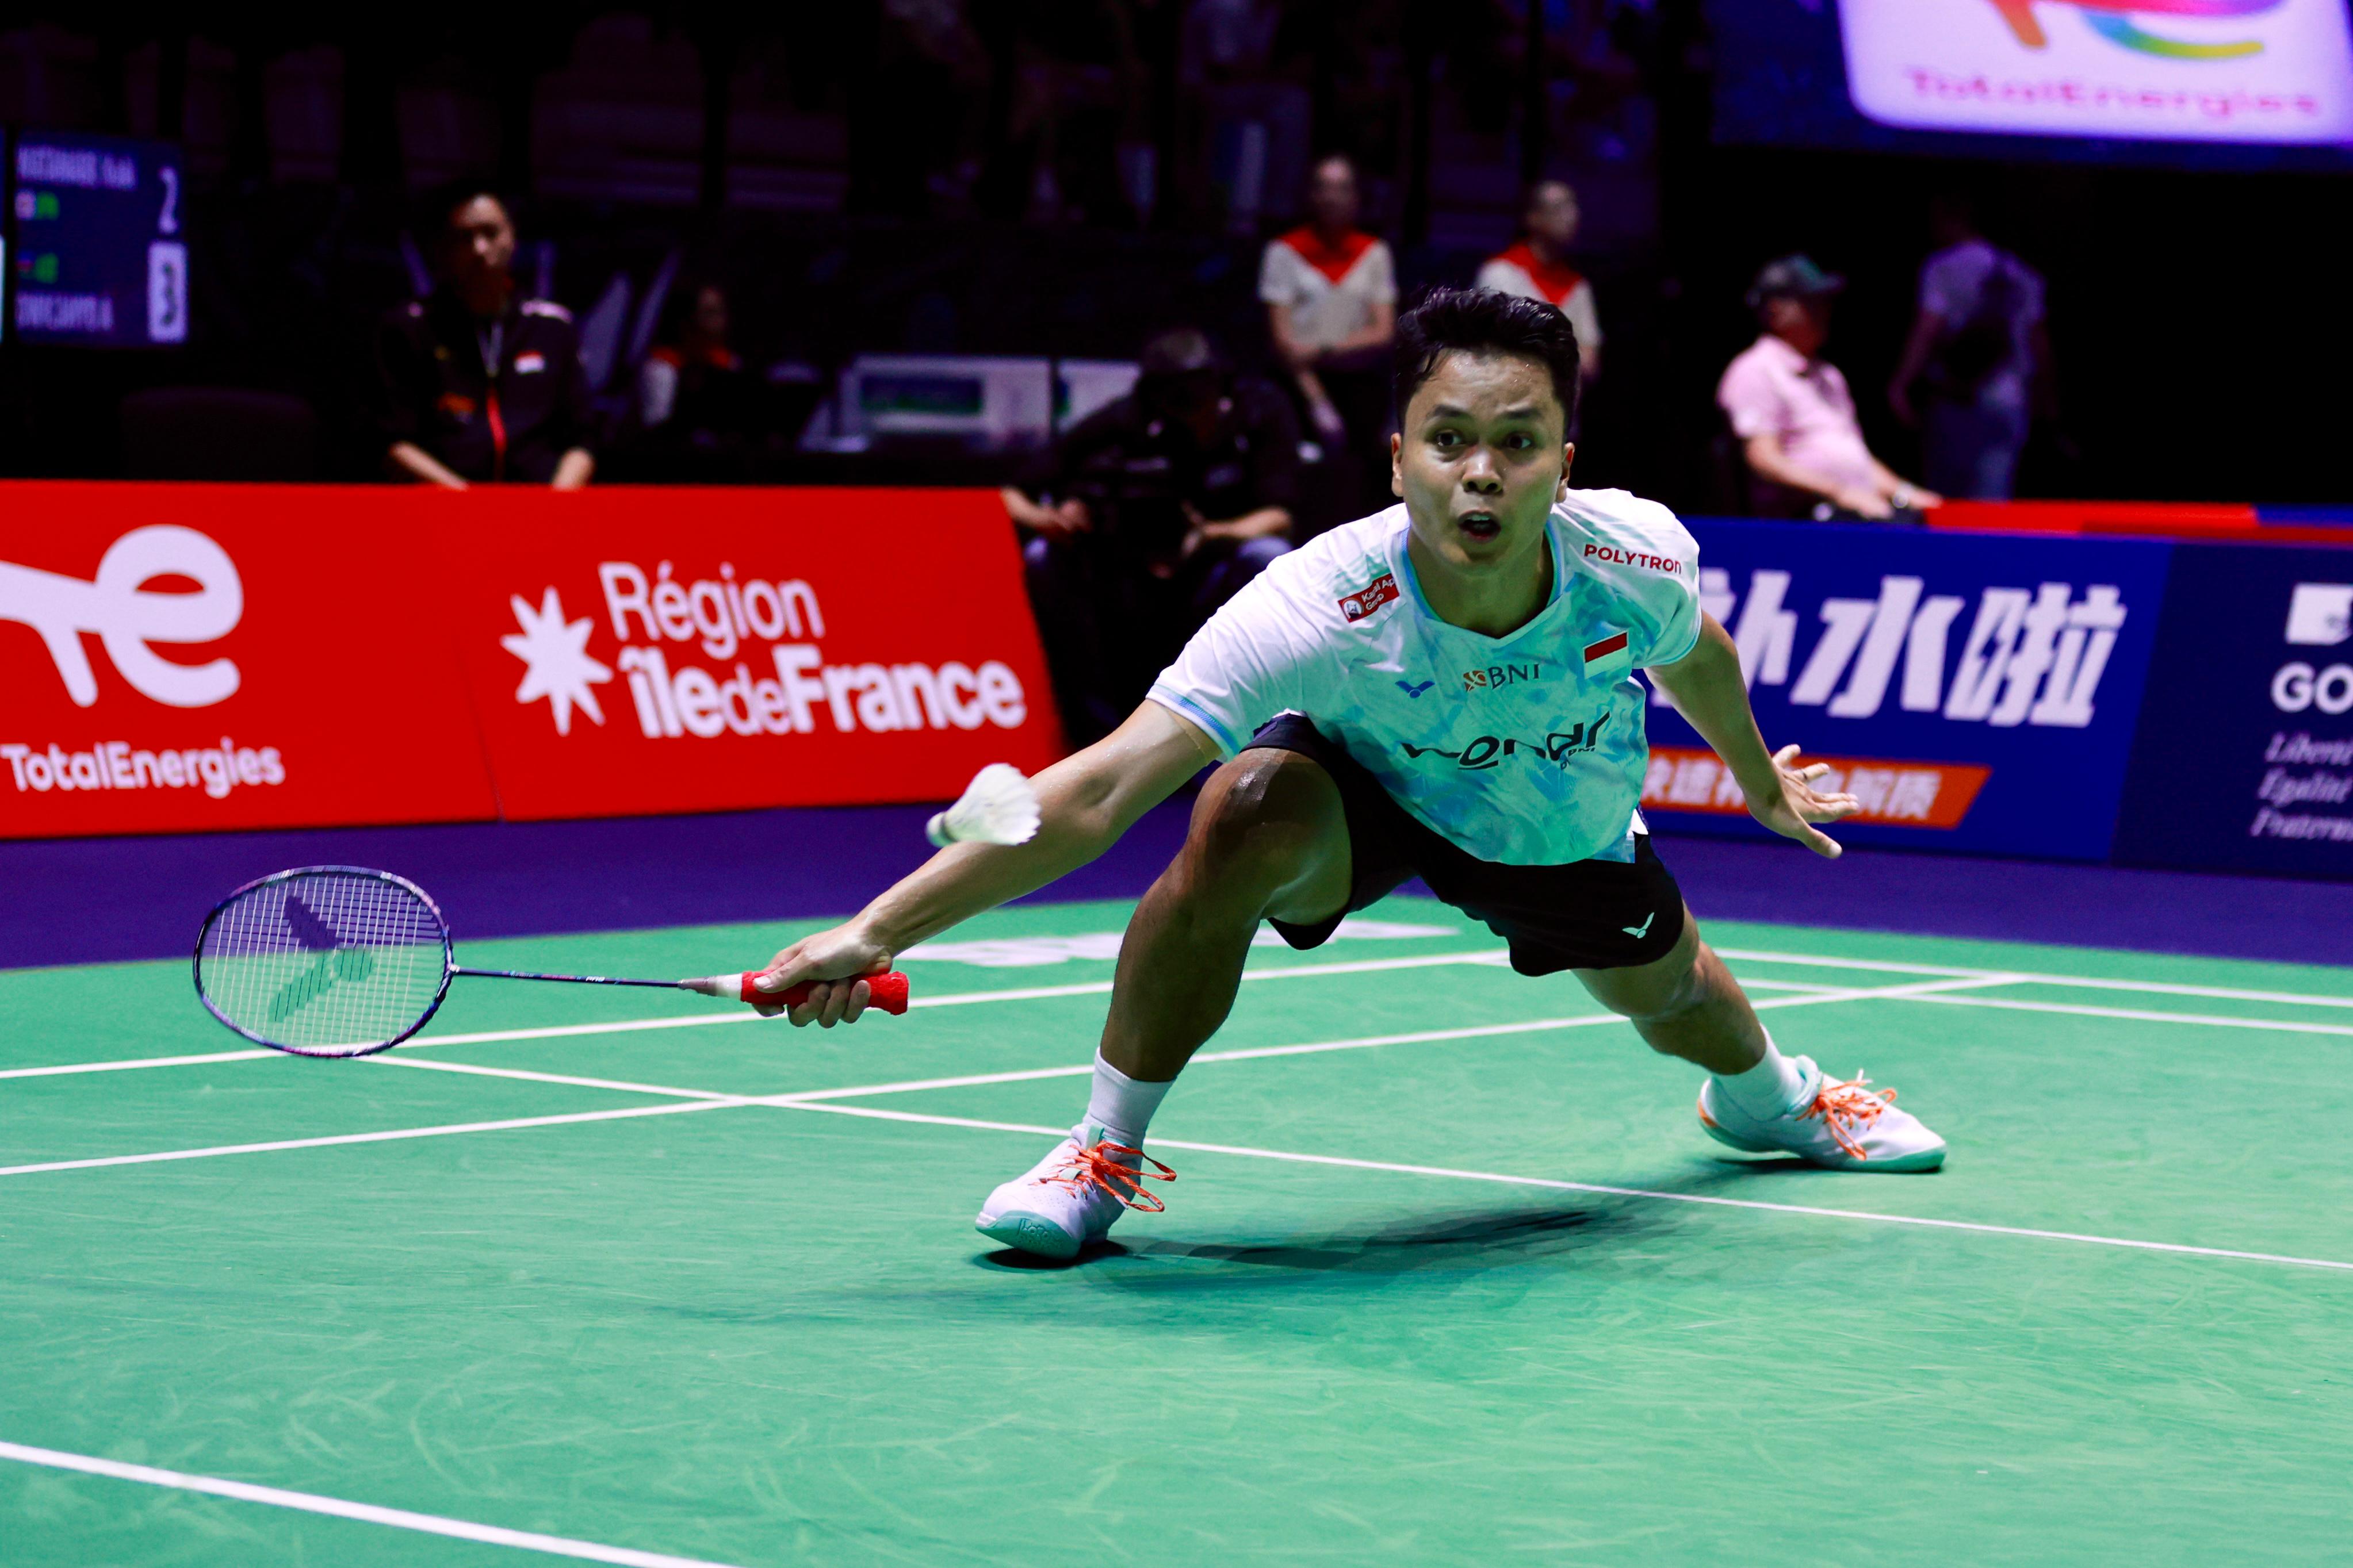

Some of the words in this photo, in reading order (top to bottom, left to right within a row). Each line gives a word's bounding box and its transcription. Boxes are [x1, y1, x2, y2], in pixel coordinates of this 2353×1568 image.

[158, 166, 178, 234] 2
[1584, 543, 1681, 574] POLYTRON
[598, 561, 825, 660] Région
[1487, 664, 1540, 690] BNI
[0, 737, 285, 799] TotalEnergies
